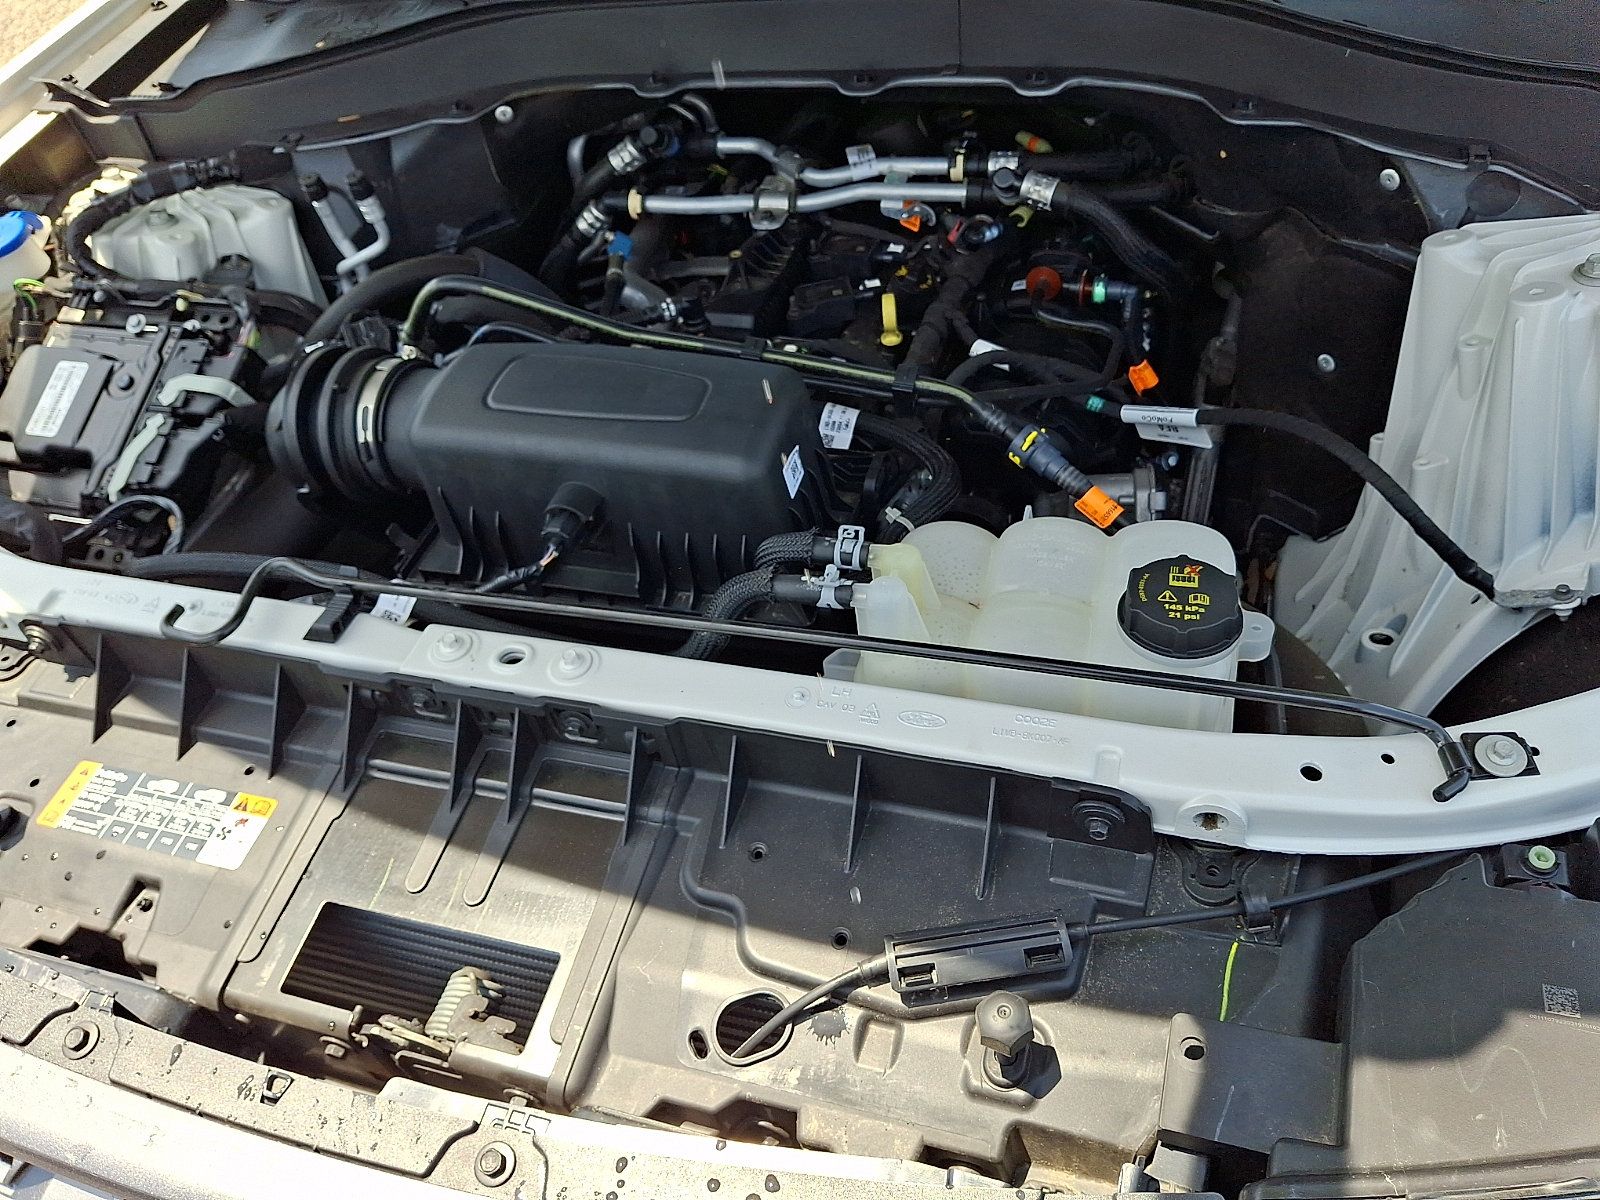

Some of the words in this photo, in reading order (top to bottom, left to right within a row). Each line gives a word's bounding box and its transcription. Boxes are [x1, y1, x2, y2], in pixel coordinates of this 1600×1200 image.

[1141, 415, 1173, 423] FoMoCo
[1163, 603, 1183, 611] 145
[1185, 605, 1205, 613] kPa
[1168, 611, 1181, 619] 21
[1184, 613, 1200, 621] psi
[831, 686, 853, 698] LH
[841, 703, 856, 713] 03
